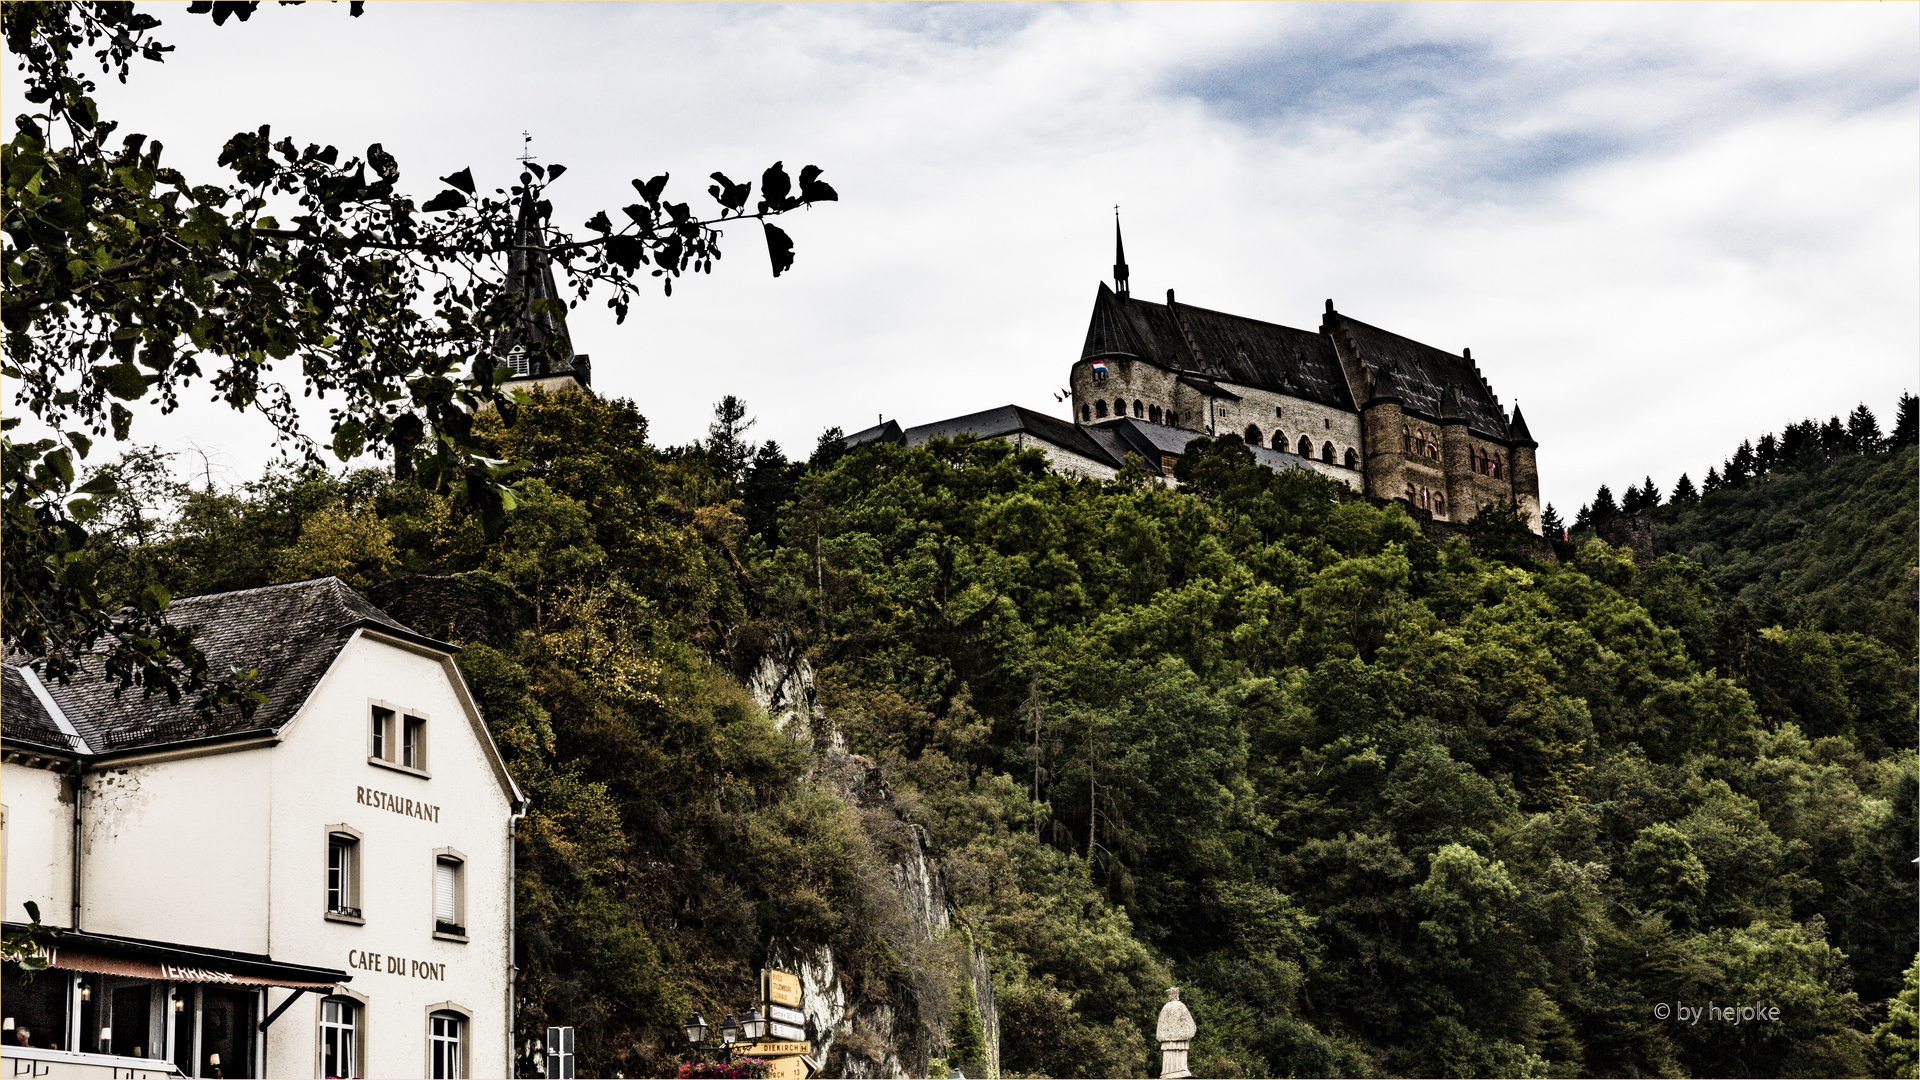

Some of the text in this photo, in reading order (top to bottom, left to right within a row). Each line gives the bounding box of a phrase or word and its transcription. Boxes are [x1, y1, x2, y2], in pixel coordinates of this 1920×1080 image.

[357, 786, 440, 823] RESTAURANT
[349, 950, 445, 981] CAFE DU PONT
[763, 1044, 799, 1052] DIEKIRCH
[796, 1059, 800, 1067] 3
